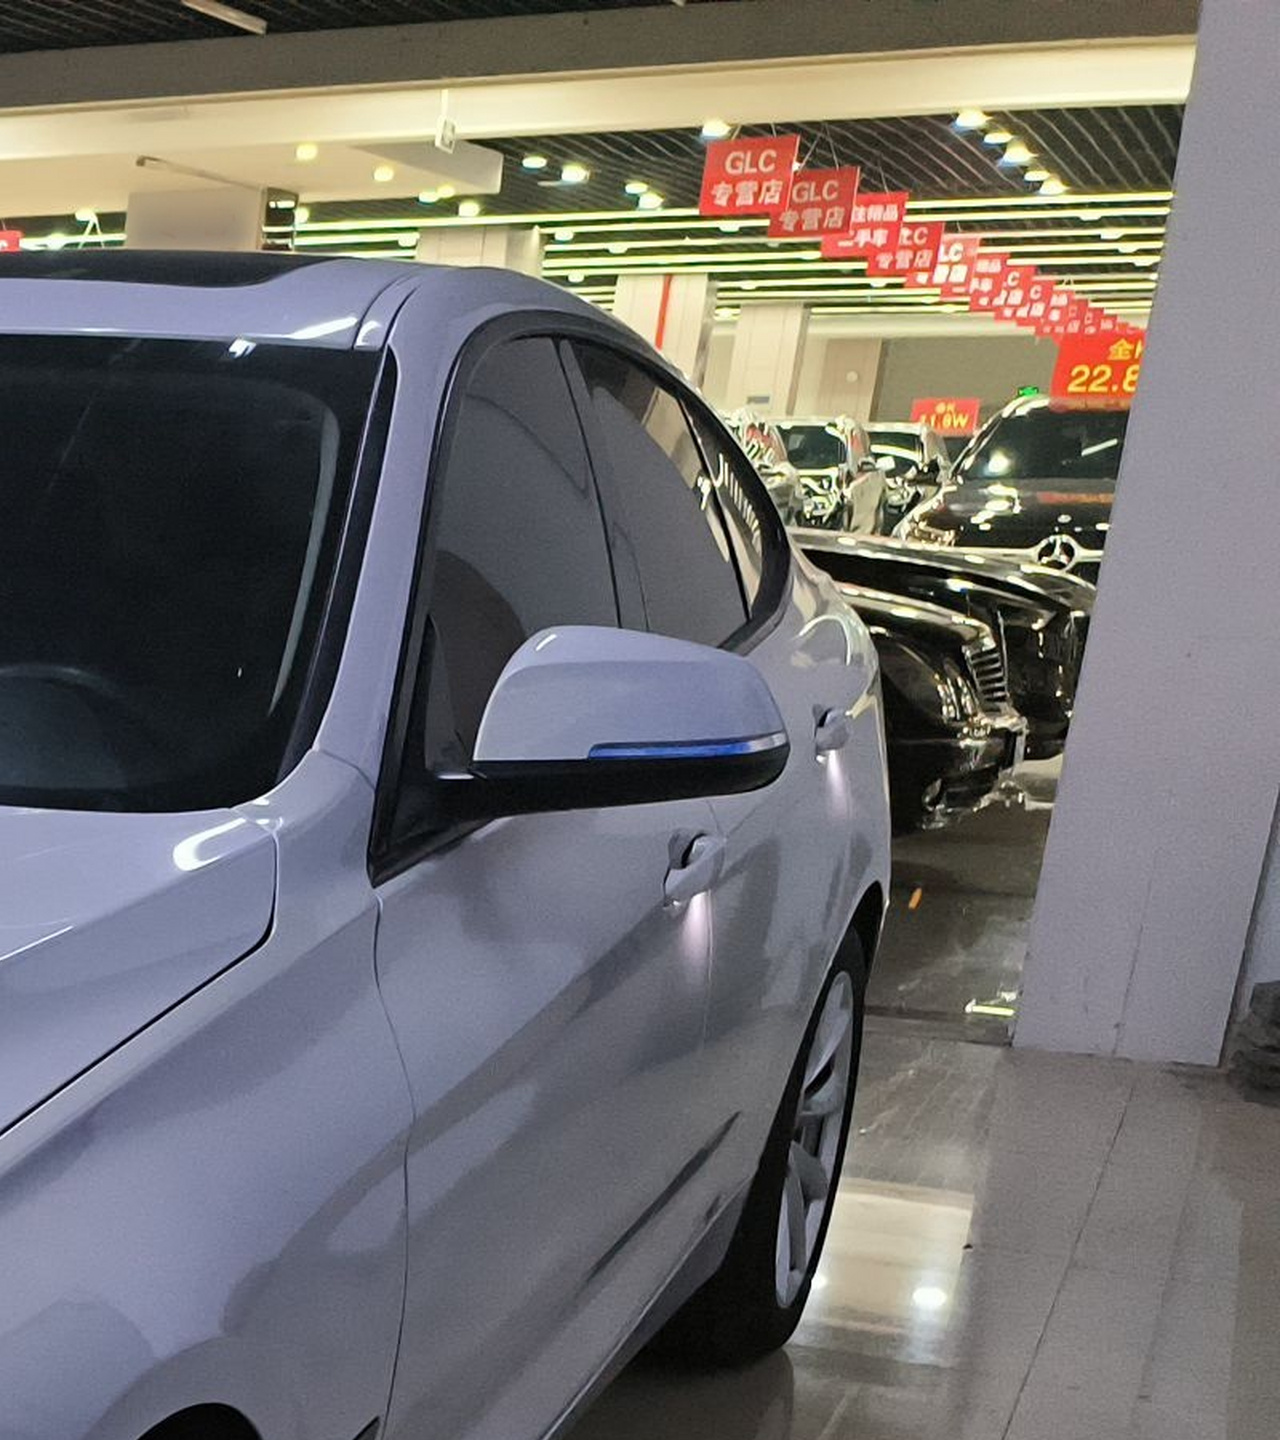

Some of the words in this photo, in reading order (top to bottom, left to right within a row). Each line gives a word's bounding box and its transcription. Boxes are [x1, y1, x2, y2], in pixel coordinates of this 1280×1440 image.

[725, 149, 777, 175] GLC
[711, 179, 783, 207] 专营店
[791, 180, 839, 203] GLC
[779, 206, 845, 231] 专营店
